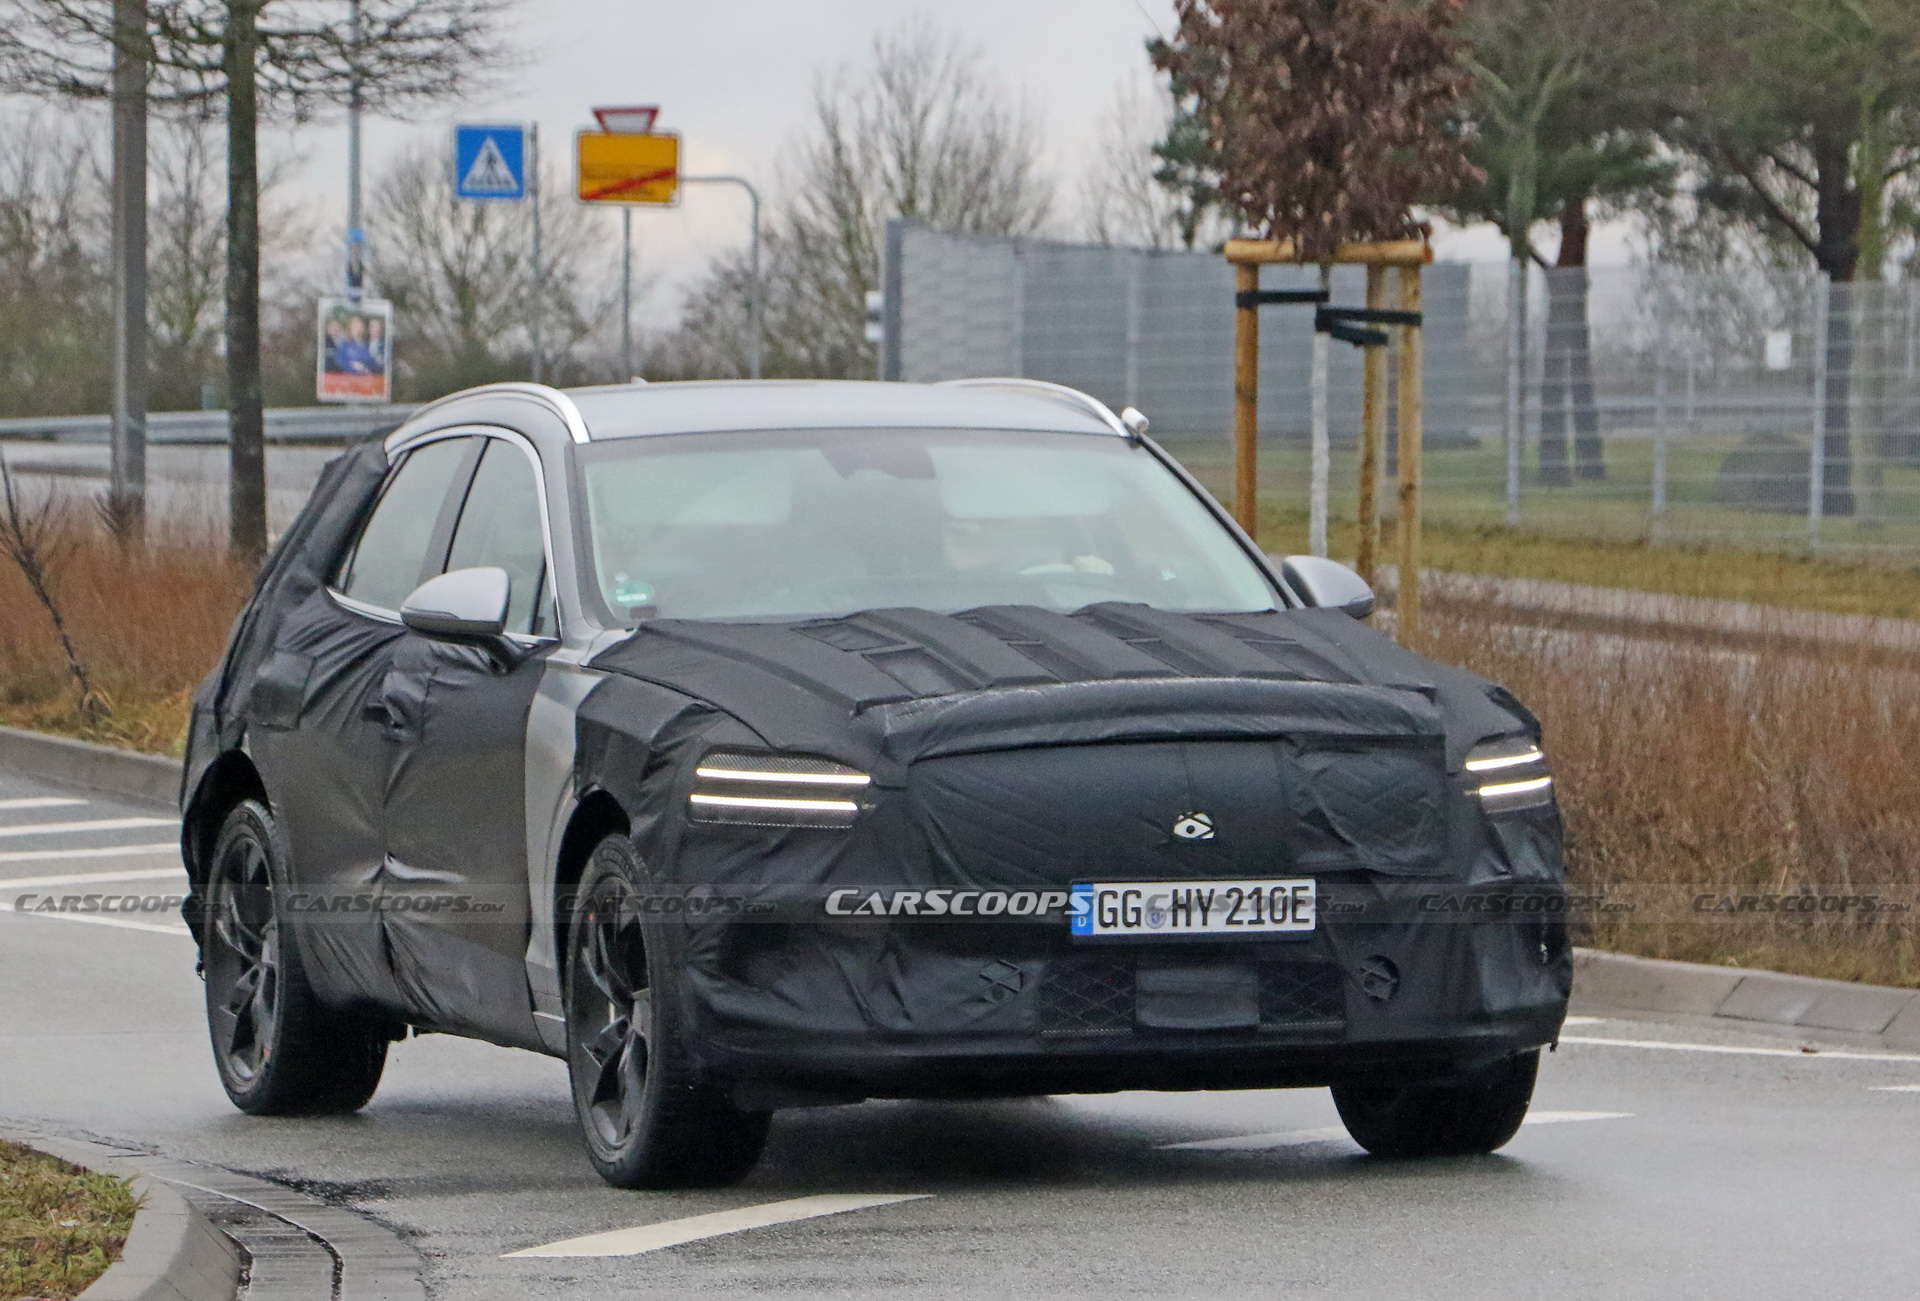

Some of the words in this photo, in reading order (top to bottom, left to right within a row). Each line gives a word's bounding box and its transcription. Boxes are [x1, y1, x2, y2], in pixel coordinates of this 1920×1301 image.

[1097, 889, 1142, 929] GG
[1171, 888, 1215, 927] HY
[1225, 886, 1310, 926] 210E
[1077, 916, 1087, 927] D
